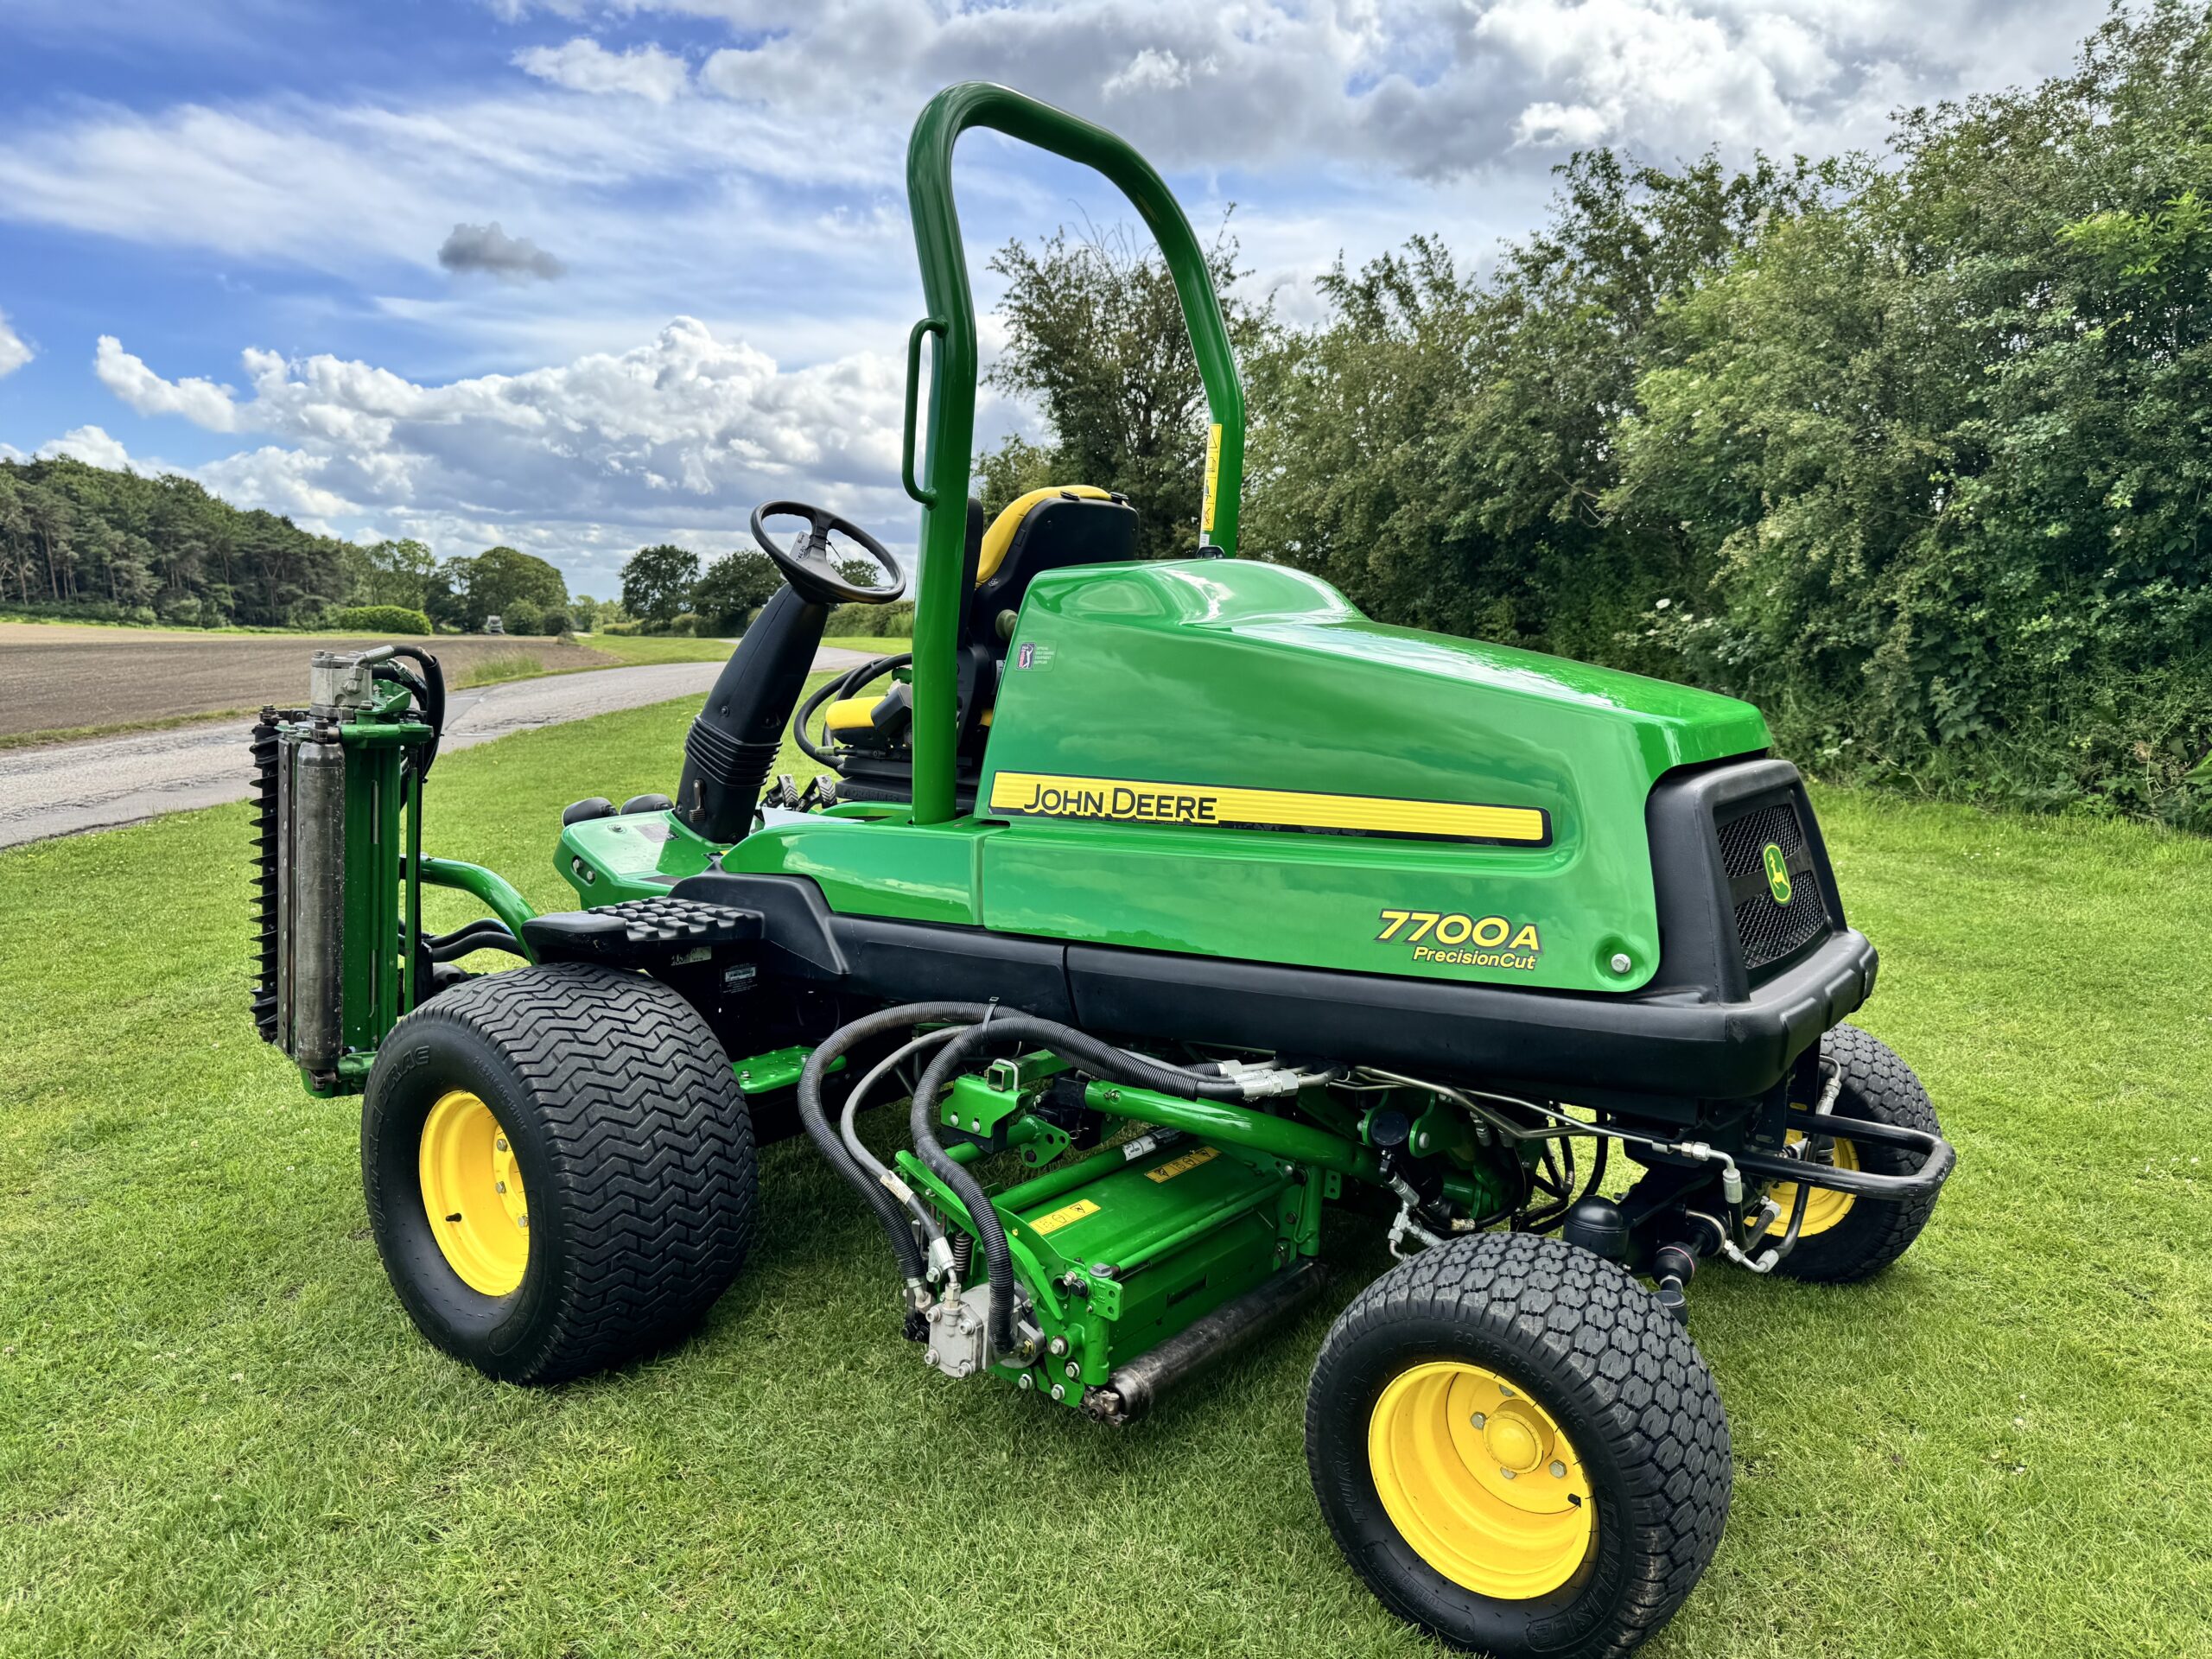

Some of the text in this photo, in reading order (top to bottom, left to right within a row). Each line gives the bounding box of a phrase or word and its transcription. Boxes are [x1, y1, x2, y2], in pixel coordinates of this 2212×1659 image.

[1024, 784, 1217, 821] JOHN DEERE
[1376, 910, 1541, 952] 7700A
[1412, 946, 1537, 970] PrecisionCut
